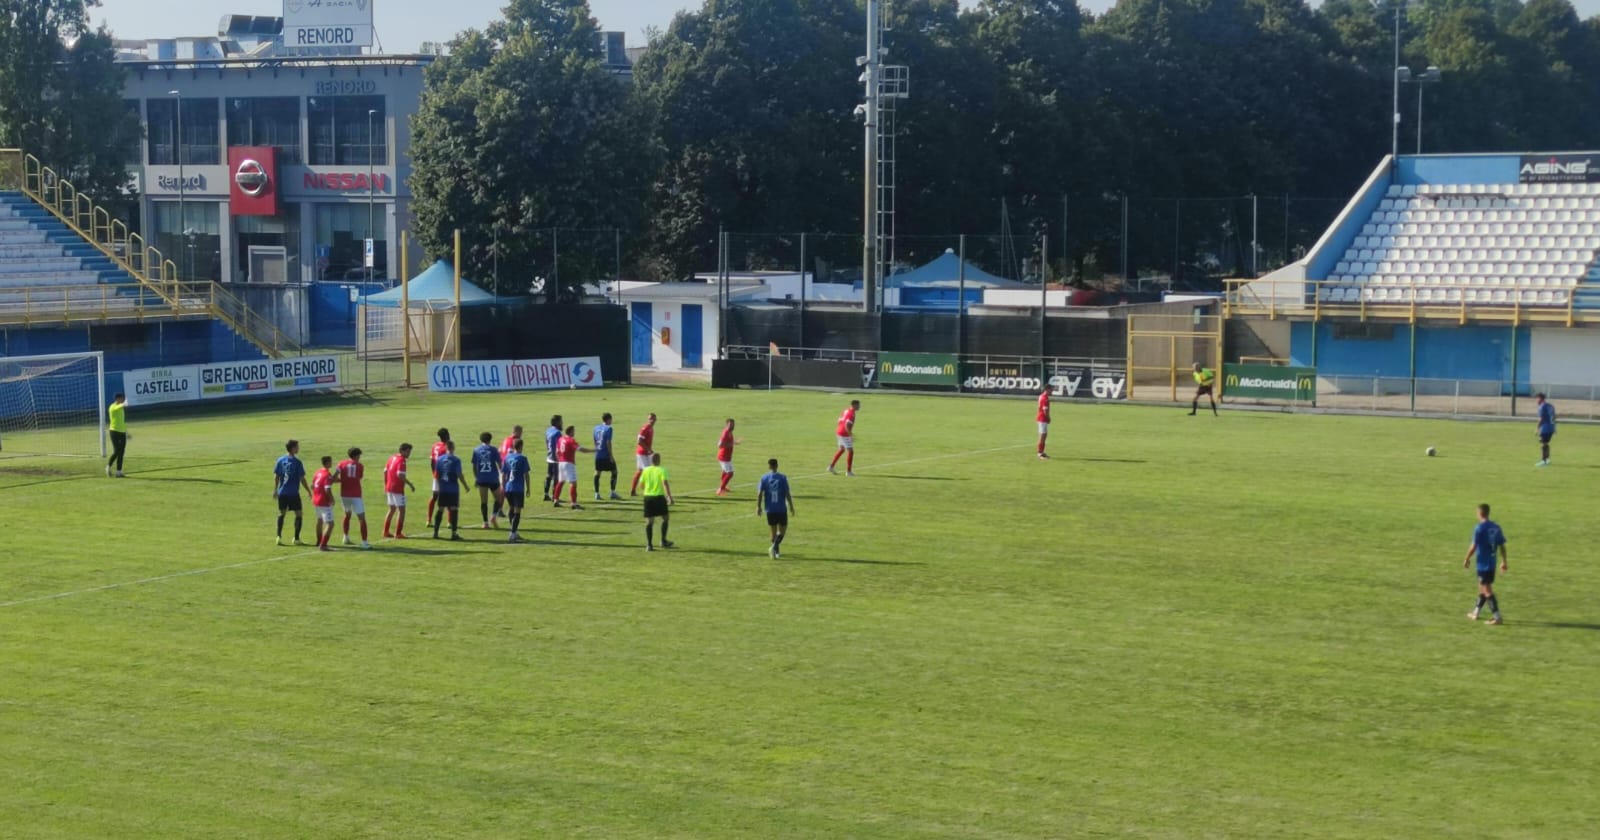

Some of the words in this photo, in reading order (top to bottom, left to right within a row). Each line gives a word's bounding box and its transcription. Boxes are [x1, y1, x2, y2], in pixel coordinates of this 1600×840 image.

[297, 27, 354, 44] RENORD
[316, 80, 376, 94] RENORD
[158, 174, 202, 187] Renord
[304, 173, 386, 190] NISSAN
[215, 364, 268, 384] RENORD
[284, 359, 336, 378] RENORD
[433, 364, 500, 388] CASTELLA
[506, 363, 572, 387] IMPIANTI
[893, 364, 942, 375] McDonald's
[135, 379, 189, 395] CASTELLO
[964, 376, 1041, 390] CALCIOSHOP
[1240, 377, 1297, 389] McDonald's
[480, 462, 492, 472] 23
